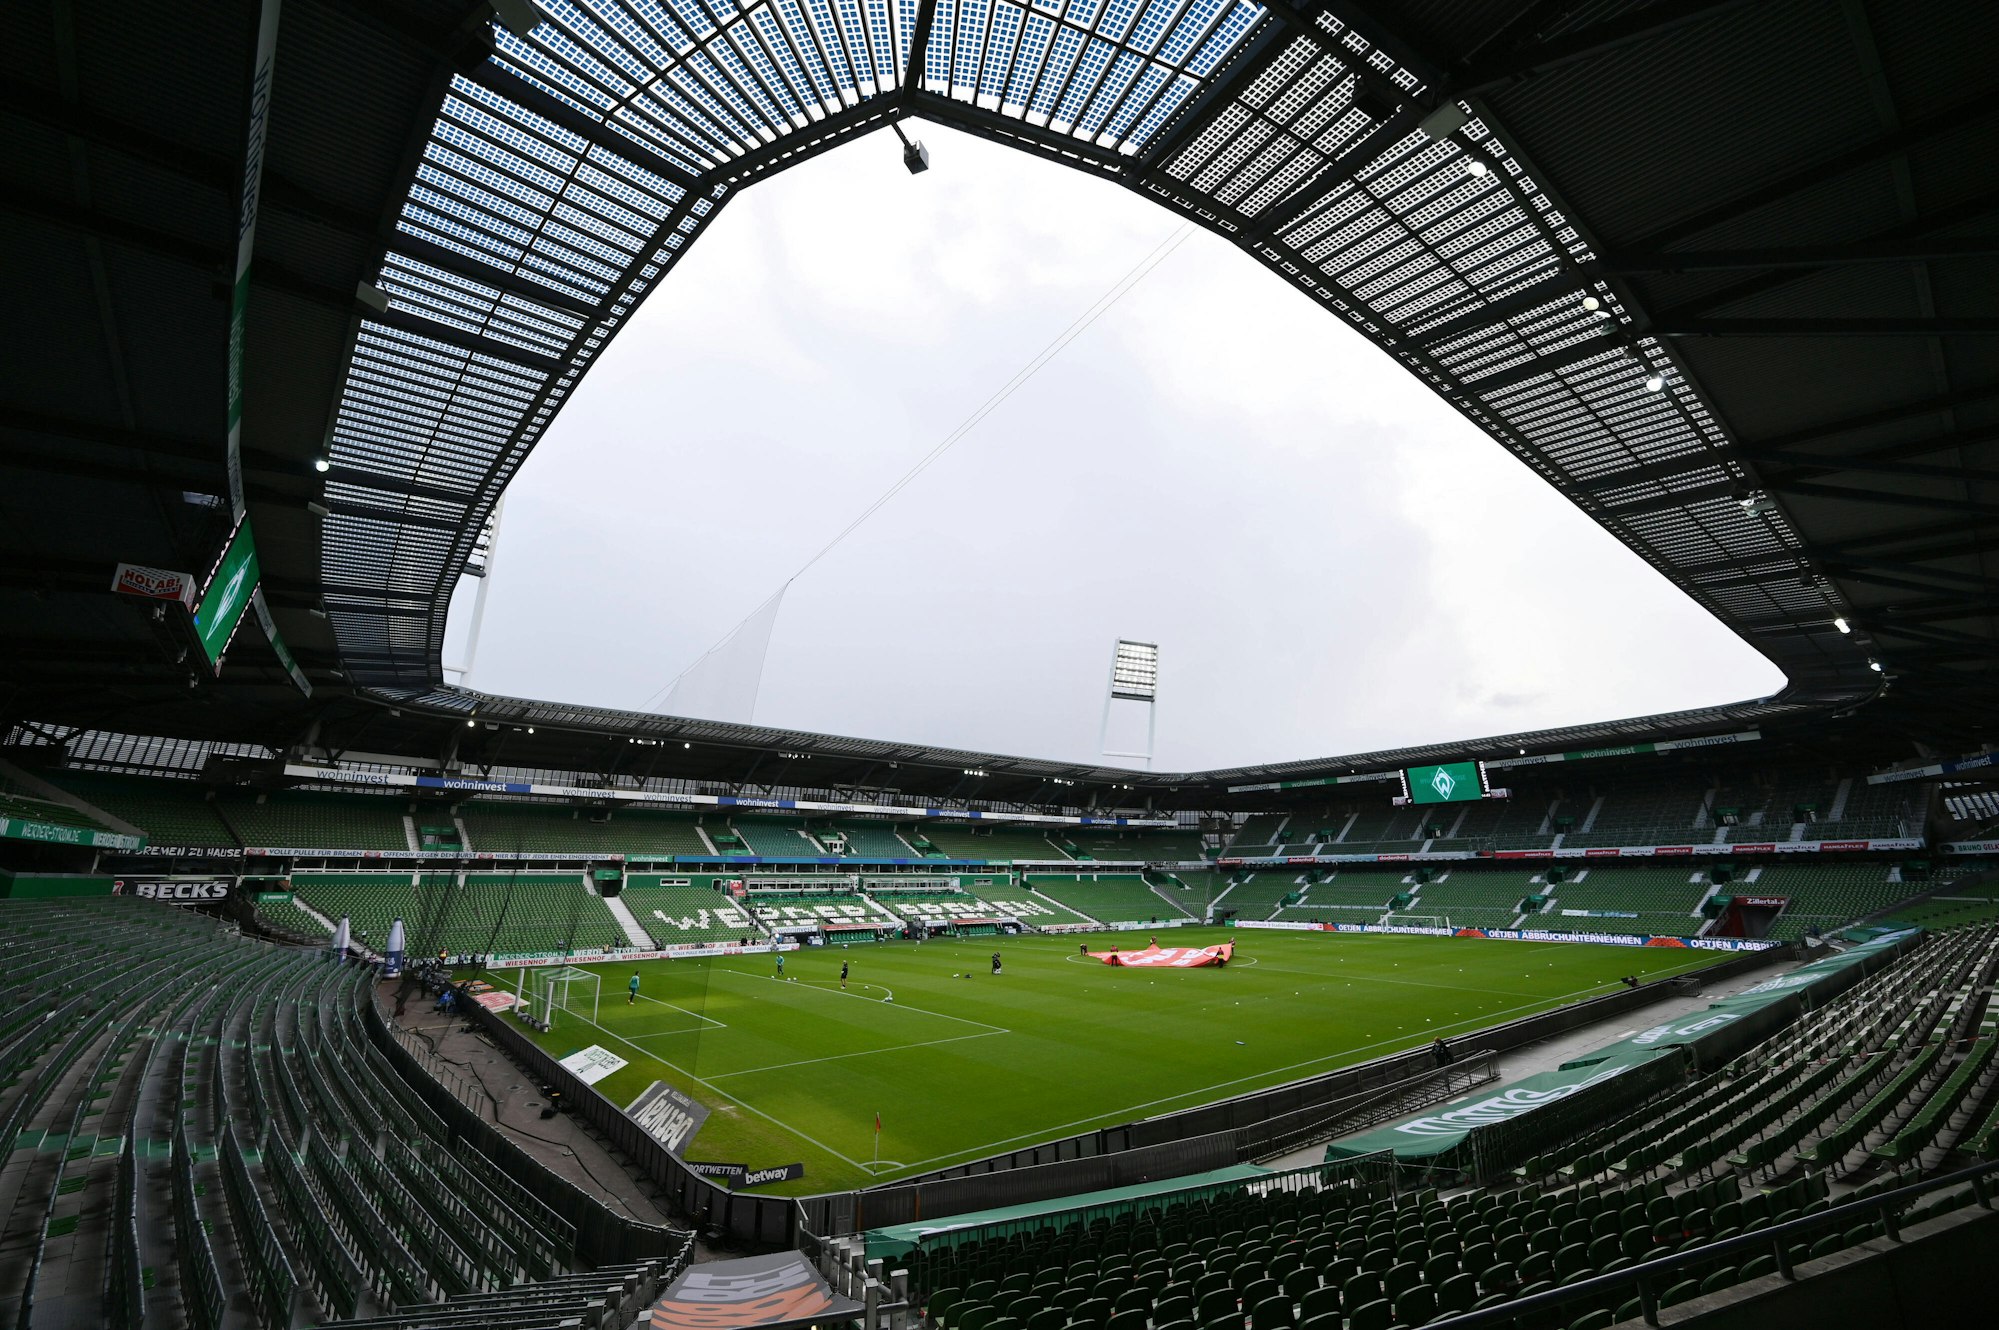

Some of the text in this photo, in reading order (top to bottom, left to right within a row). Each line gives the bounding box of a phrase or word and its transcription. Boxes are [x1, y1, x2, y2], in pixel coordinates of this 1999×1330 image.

[1675, 733, 1738, 750] wohninvest
[1581, 746, 1636, 759] wohninvest
[1500, 755, 1548, 768] wohninvest
[1955, 755, 1992, 771] wohninvest
[317, 769, 389, 784] wohninvest
[1350, 773, 1387, 783] wohninvest
[1884, 767, 1926, 783] wohninvest
[443, 780, 507, 792] wohninvest
[1291, 779, 1326, 788] wohninvest
[562, 788, 616, 799] wohninvest
[643, 793, 692, 803] wohninvest
[736, 798, 779, 807] wohninvest
[816, 803, 854, 812] wohninvest
[873, 806, 908, 814] wohninvest
[938, 810, 970, 819] wohninvest
[188, 847, 204, 857] ZU
[206, 847, 242, 858] HAUSE
[269, 848, 292, 856] VOLLE
[333, 850, 363, 858] BREMEN
[1379, 854, 1408, 862] dodenhof
[631, 854, 668, 863] wohninvest
[778, 925, 813, 934] wohninvest
[1339, 923, 1361, 932] OETJEN
[1363, 925, 1453, 936] ABBRUCHUNTERNEHMEN
[1488, 930, 1519, 939] OETJEN
[1521, 932, 1642, 945] ABBRUCHUNTERNEHMEN
[505, 952, 658, 967] WIESENHOF WIESENHOF WIESENHOF
[745, 1166, 789, 1185] betway
